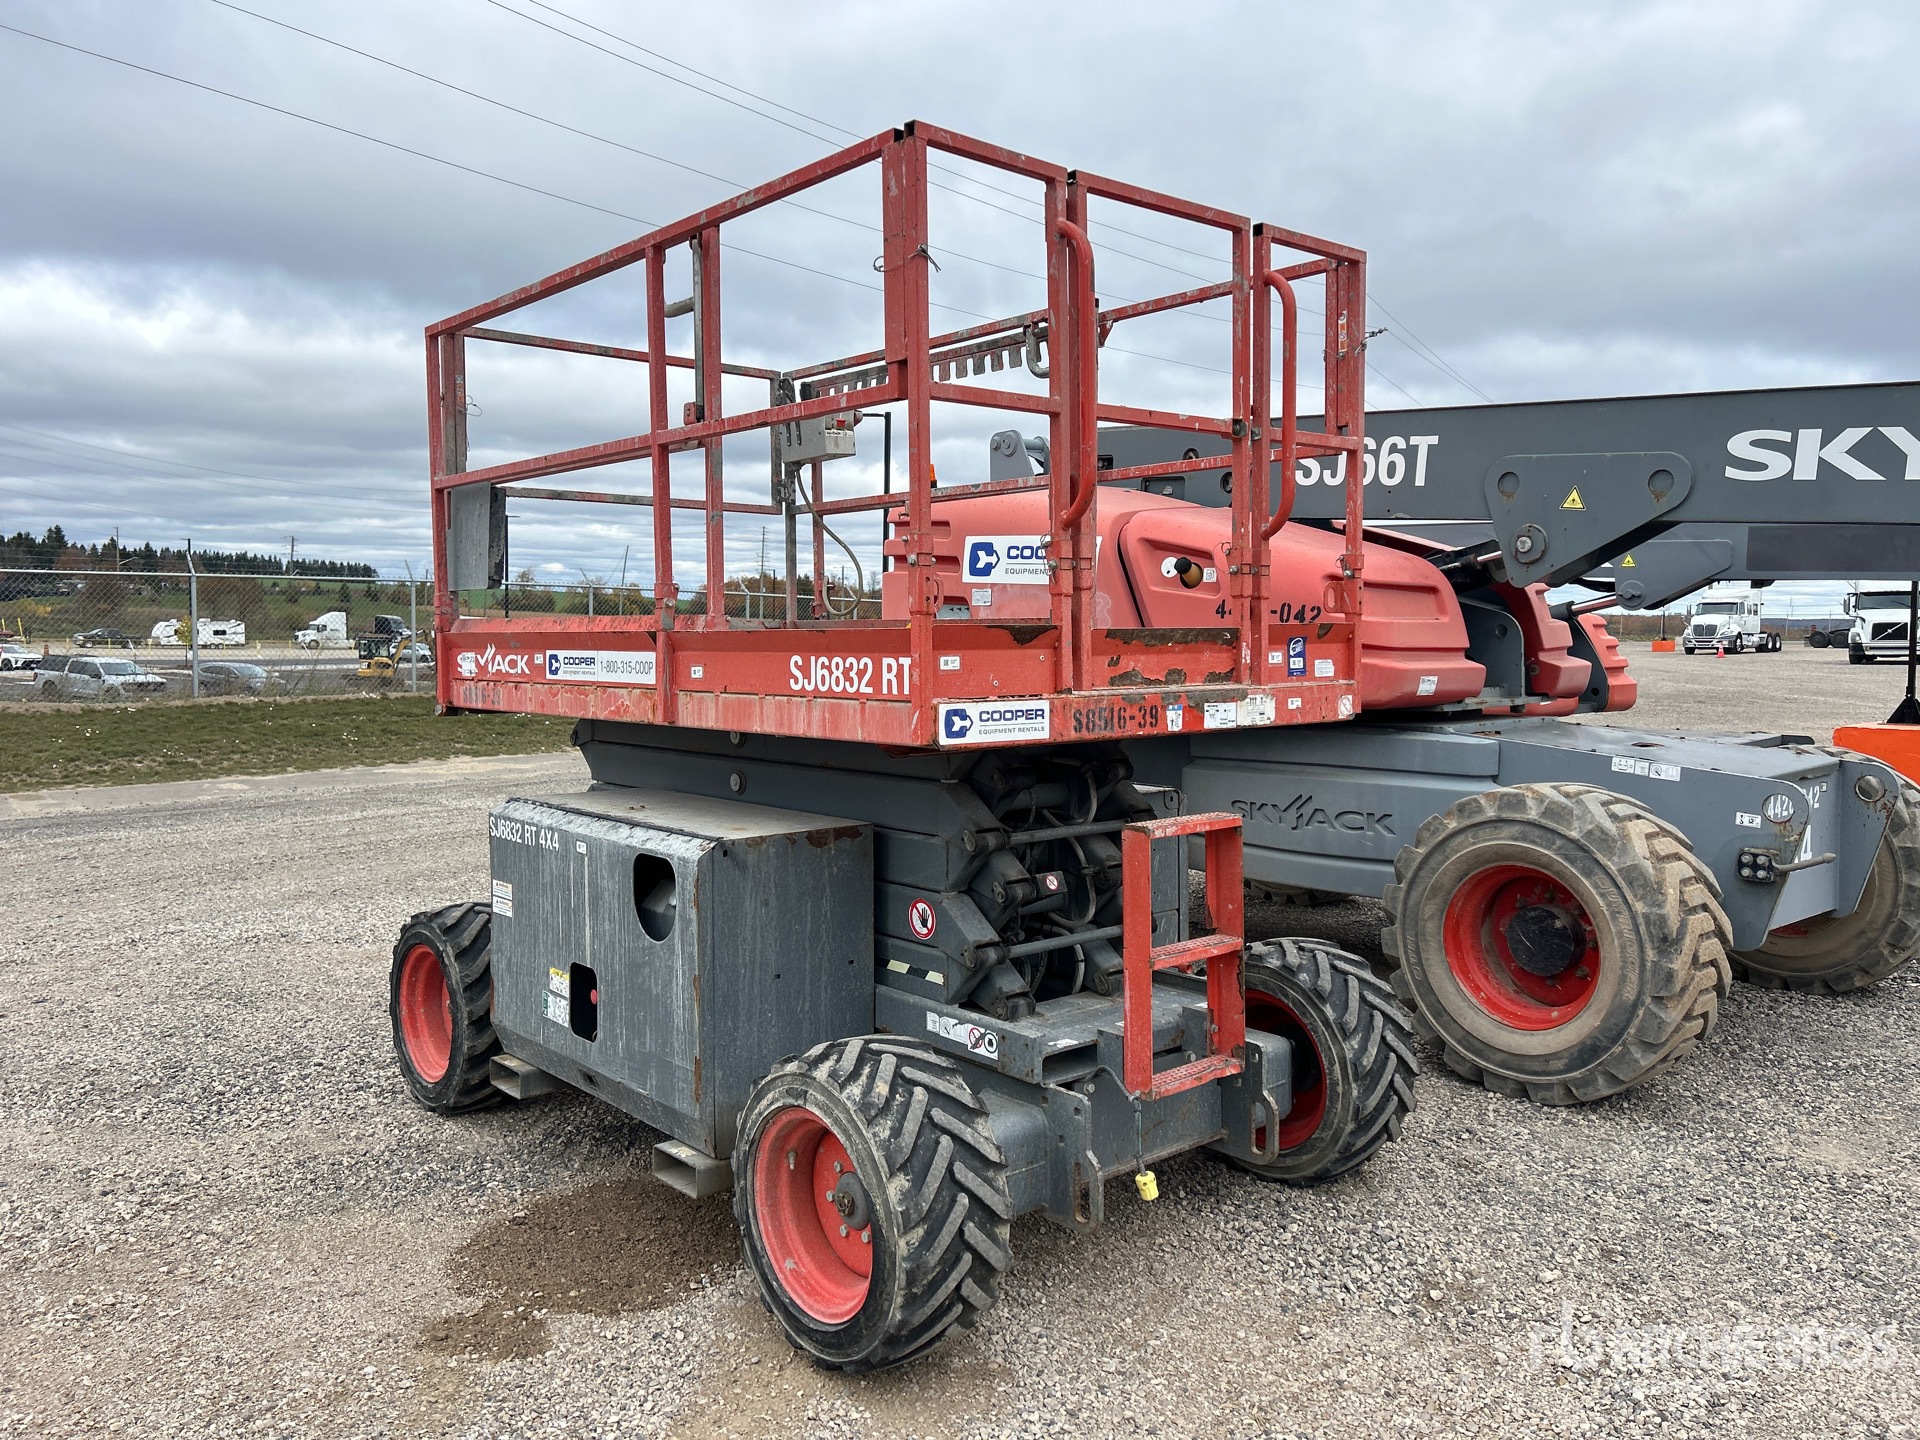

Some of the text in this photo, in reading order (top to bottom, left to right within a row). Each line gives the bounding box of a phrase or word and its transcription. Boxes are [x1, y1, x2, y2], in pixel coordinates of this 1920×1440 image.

[563, 655, 596, 667] COOPER
[600, 660, 654, 675] 1-800-315-COOP
[789, 654, 912, 695] SJ6832 RT
[979, 708, 1045, 723] COOPER
[978, 725, 1045, 736] EQUIPMENT RENTALS
[1231, 793, 1397, 837] SKYJACK
[489, 816, 560, 852] SJ6832 RT 4X4
